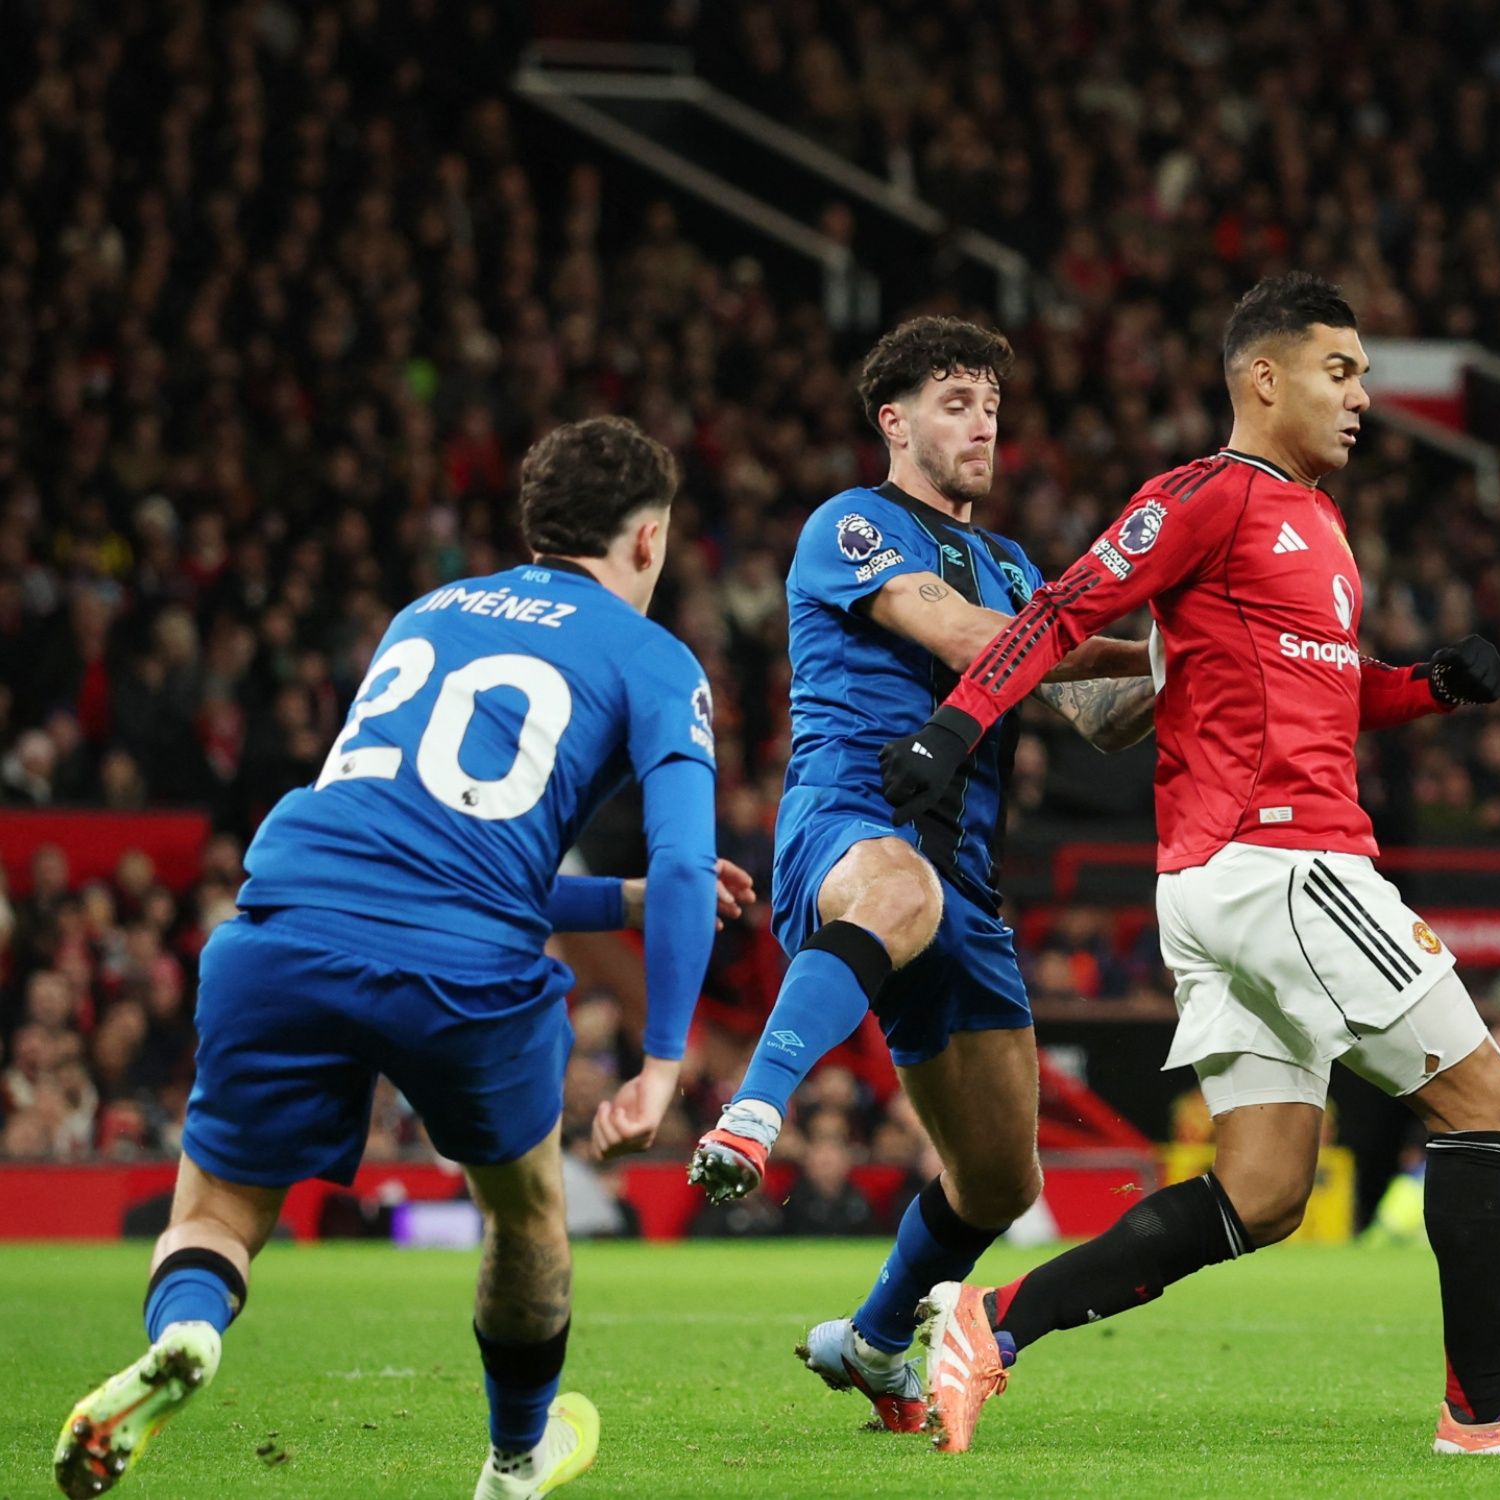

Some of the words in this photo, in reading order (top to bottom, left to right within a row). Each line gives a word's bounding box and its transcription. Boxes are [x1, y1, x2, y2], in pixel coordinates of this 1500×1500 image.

[869, 549, 896, 568] room
[872, 555, 904, 576] racism
[1099, 553, 1127, 581] racism
[1107, 548, 1131, 571] room
[521, 570, 552, 584] AFCB
[415, 587, 577, 628] JIMÉNEZ
[314, 637, 572, 821] 20
